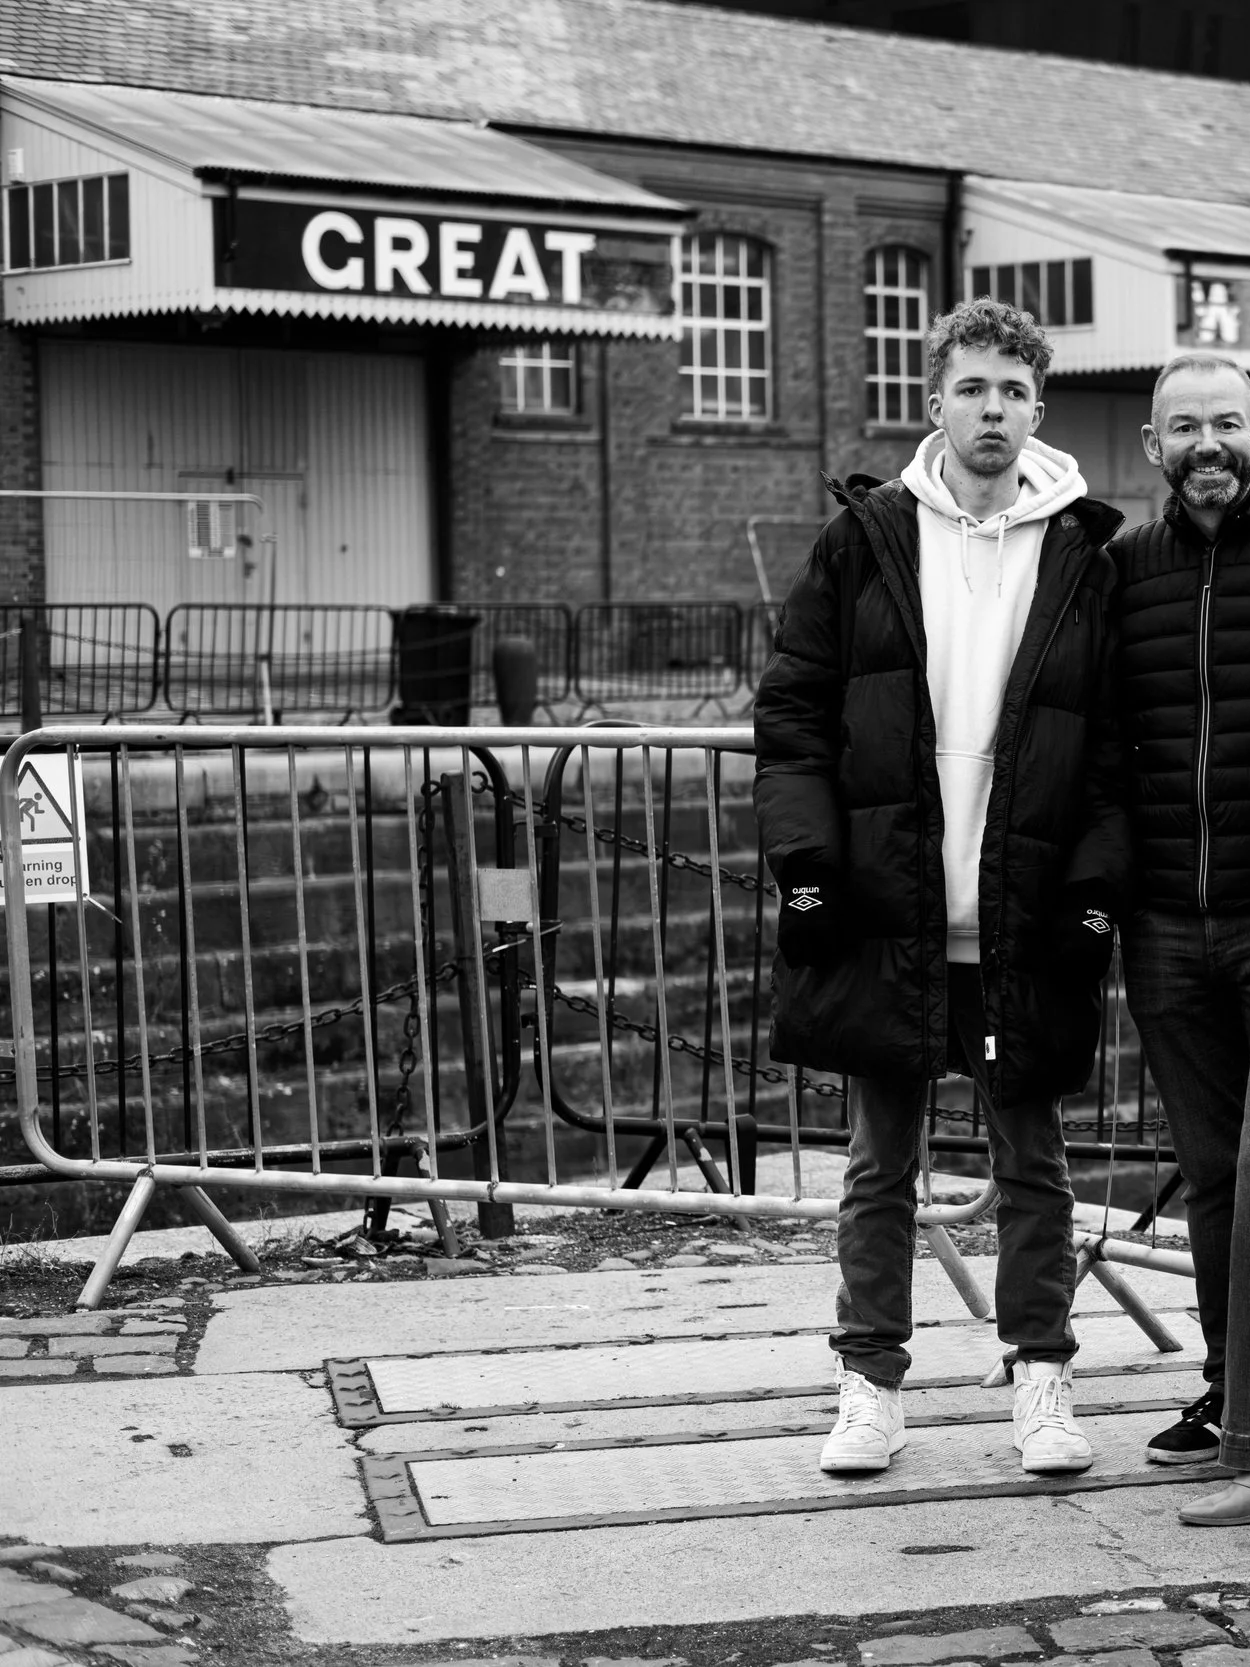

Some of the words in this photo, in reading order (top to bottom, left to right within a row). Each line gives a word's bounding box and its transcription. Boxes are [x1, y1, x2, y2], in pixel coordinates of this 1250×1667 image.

[302, 211, 596, 304] GREAT
[792, 886, 820, 895] umbro
[1086, 909, 1109, 918] mbro
